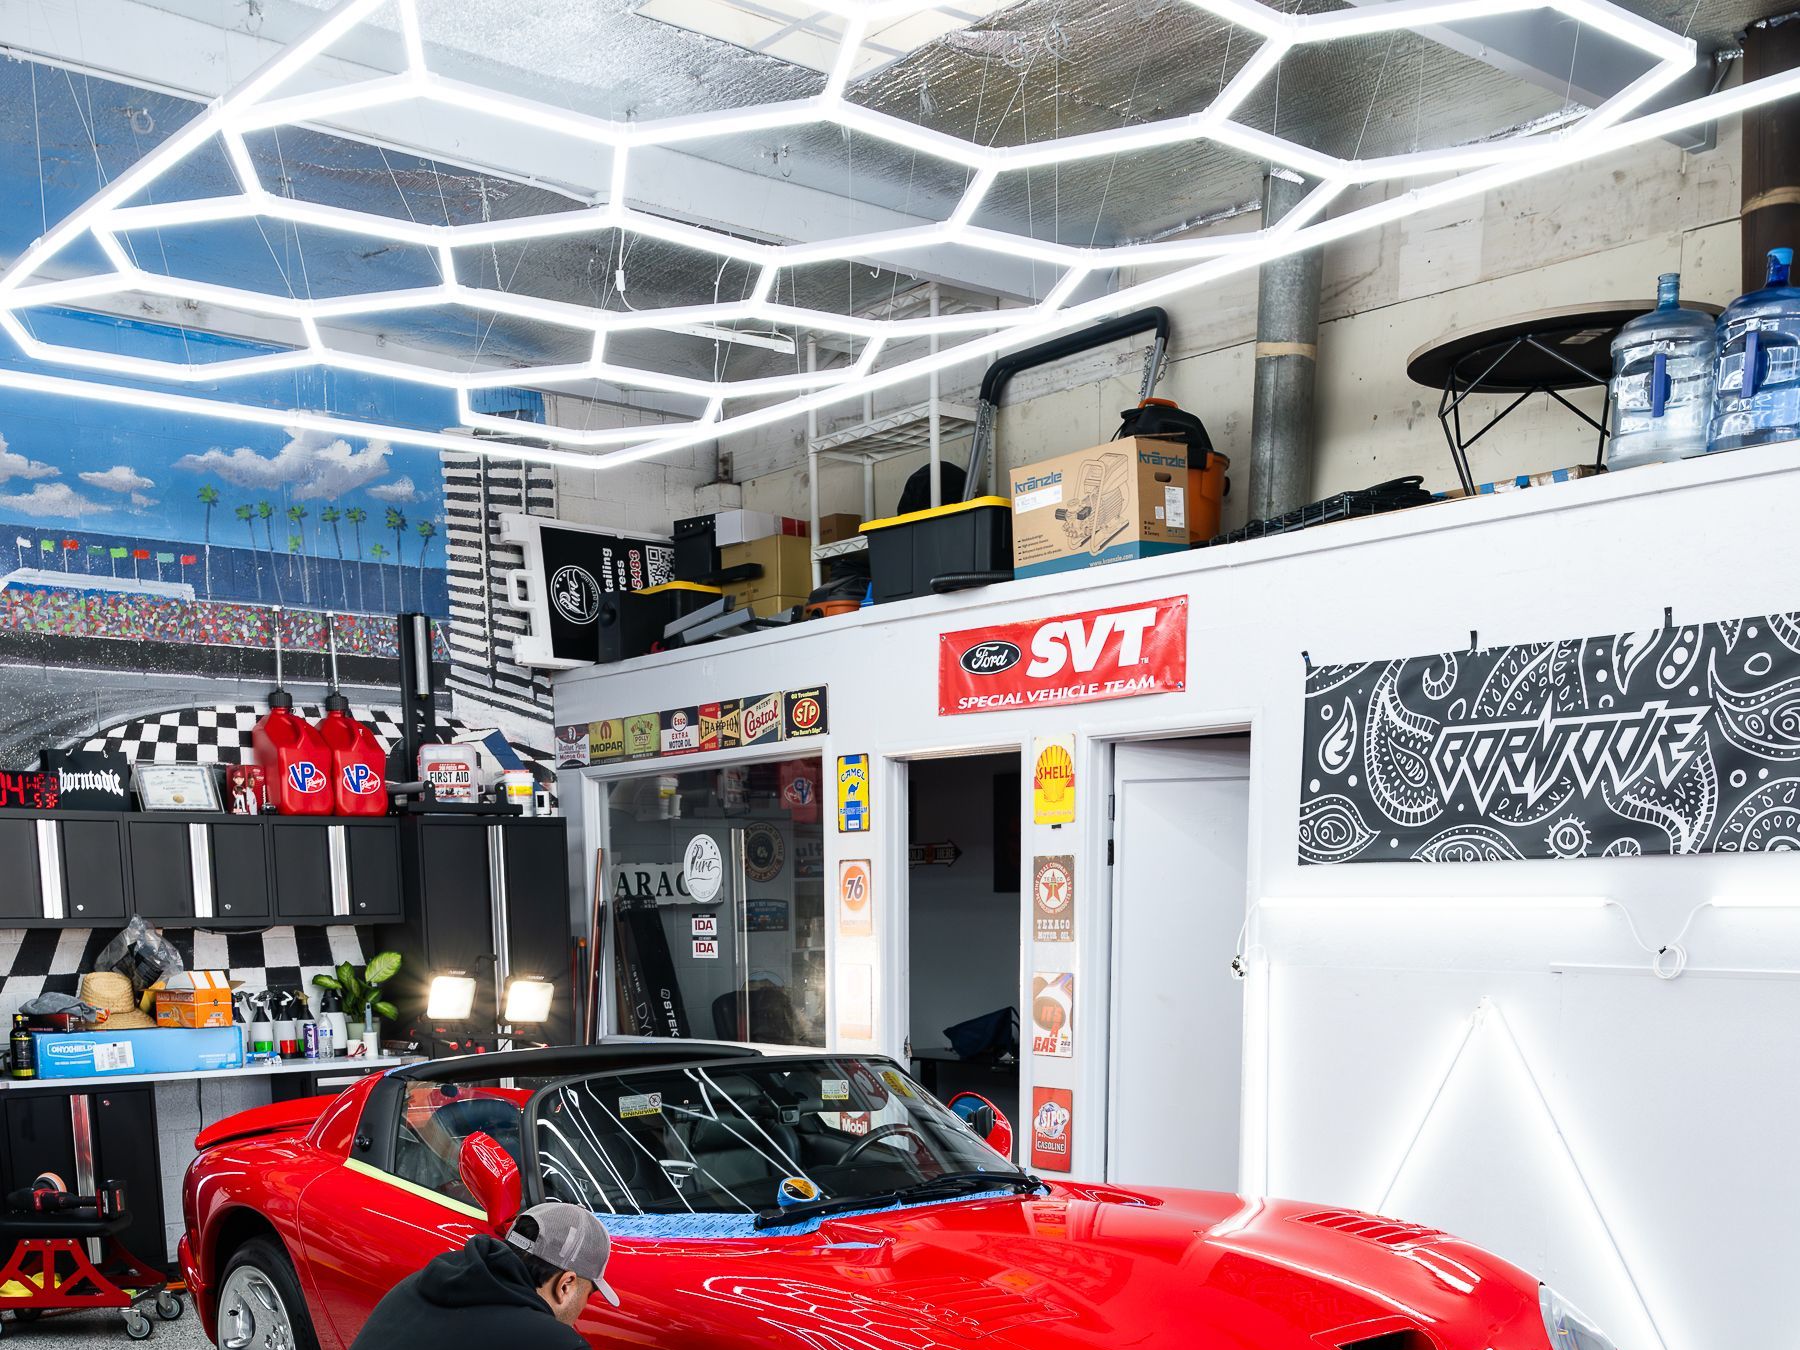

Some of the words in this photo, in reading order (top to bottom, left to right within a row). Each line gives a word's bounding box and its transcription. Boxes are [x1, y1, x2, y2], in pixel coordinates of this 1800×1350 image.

[602, 547, 614, 593] tailing
[629, 549, 643, 590] 5483
[1026, 607, 1158, 677] SVT
[972, 646, 1008, 669] Ford
[958, 691, 1023, 710] SPECIAL
[1026, 683, 1099, 703] VEHICLE
[1104, 675, 1155, 694] TEAM
[744, 700, 778, 739] Castrol
[796, 702, 817, 723] STP
[701, 713, 739, 740] CHAMPION
[672, 732, 689, 740] EXTRA
[591, 741, 623, 754] MOPAR
[669, 741, 684, 749] MOTOR
[290, 763, 315, 792] VP
[345, 765, 370, 793] VP
[430, 772, 452, 783] FIRST
[456, 771, 470, 783] AID
[840, 768, 866, 783] CAMEL
[1039, 765, 1070, 780] SHELL
[846, 876, 864, 899] 76
[695, 920, 714, 931] IDA
[1037, 919, 1070, 930] TEXACO
[696, 943, 714, 953] IDA
[664, 1001, 680, 1037] STEK
[1033, 1036, 1057, 1053] GAS
[623, 1108, 654, 1118] WARNING
[842, 1118, 868, 1135] Mobil
[1037, 1140, 1064, 1152] GASOLINE
